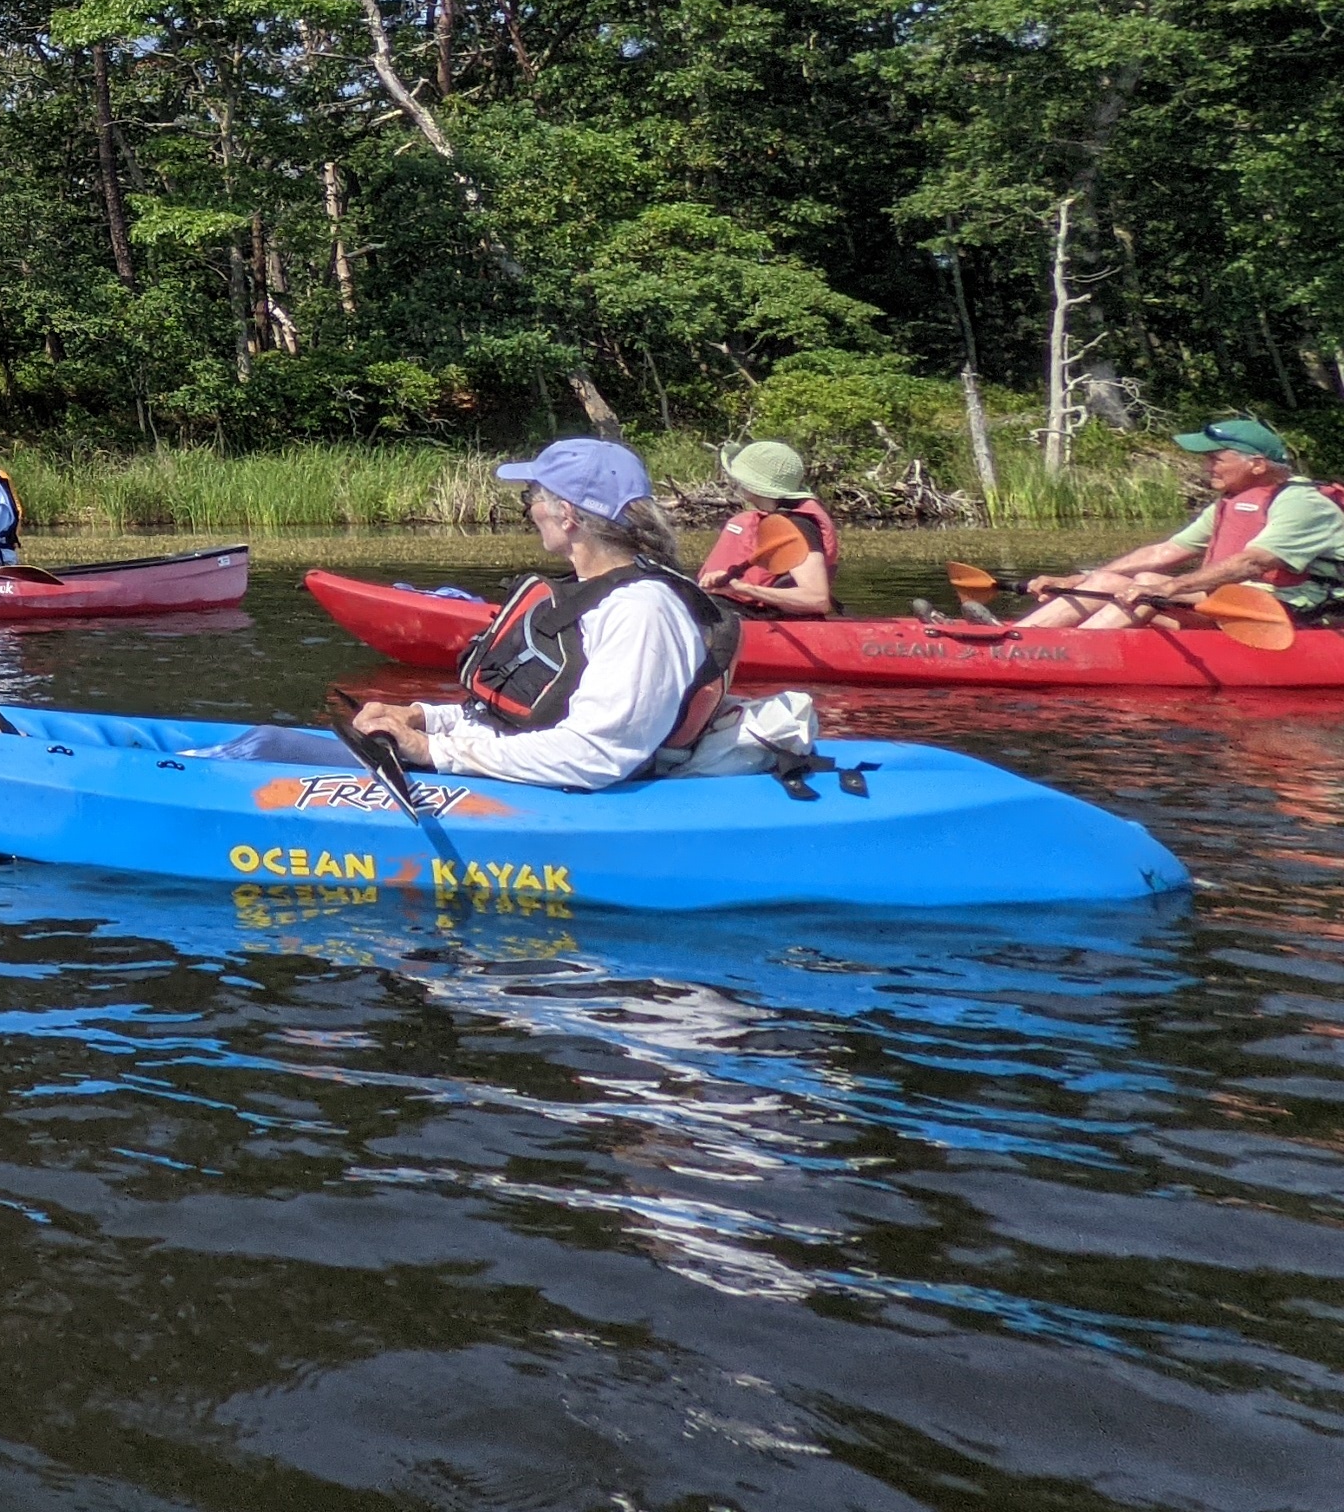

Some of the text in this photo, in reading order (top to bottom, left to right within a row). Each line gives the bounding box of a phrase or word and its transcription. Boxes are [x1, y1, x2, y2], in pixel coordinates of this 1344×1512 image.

[862, 641, 1070, 661] OCEAN KAYAK
[229, 845, 572, 893] OCEAN KAYAK
